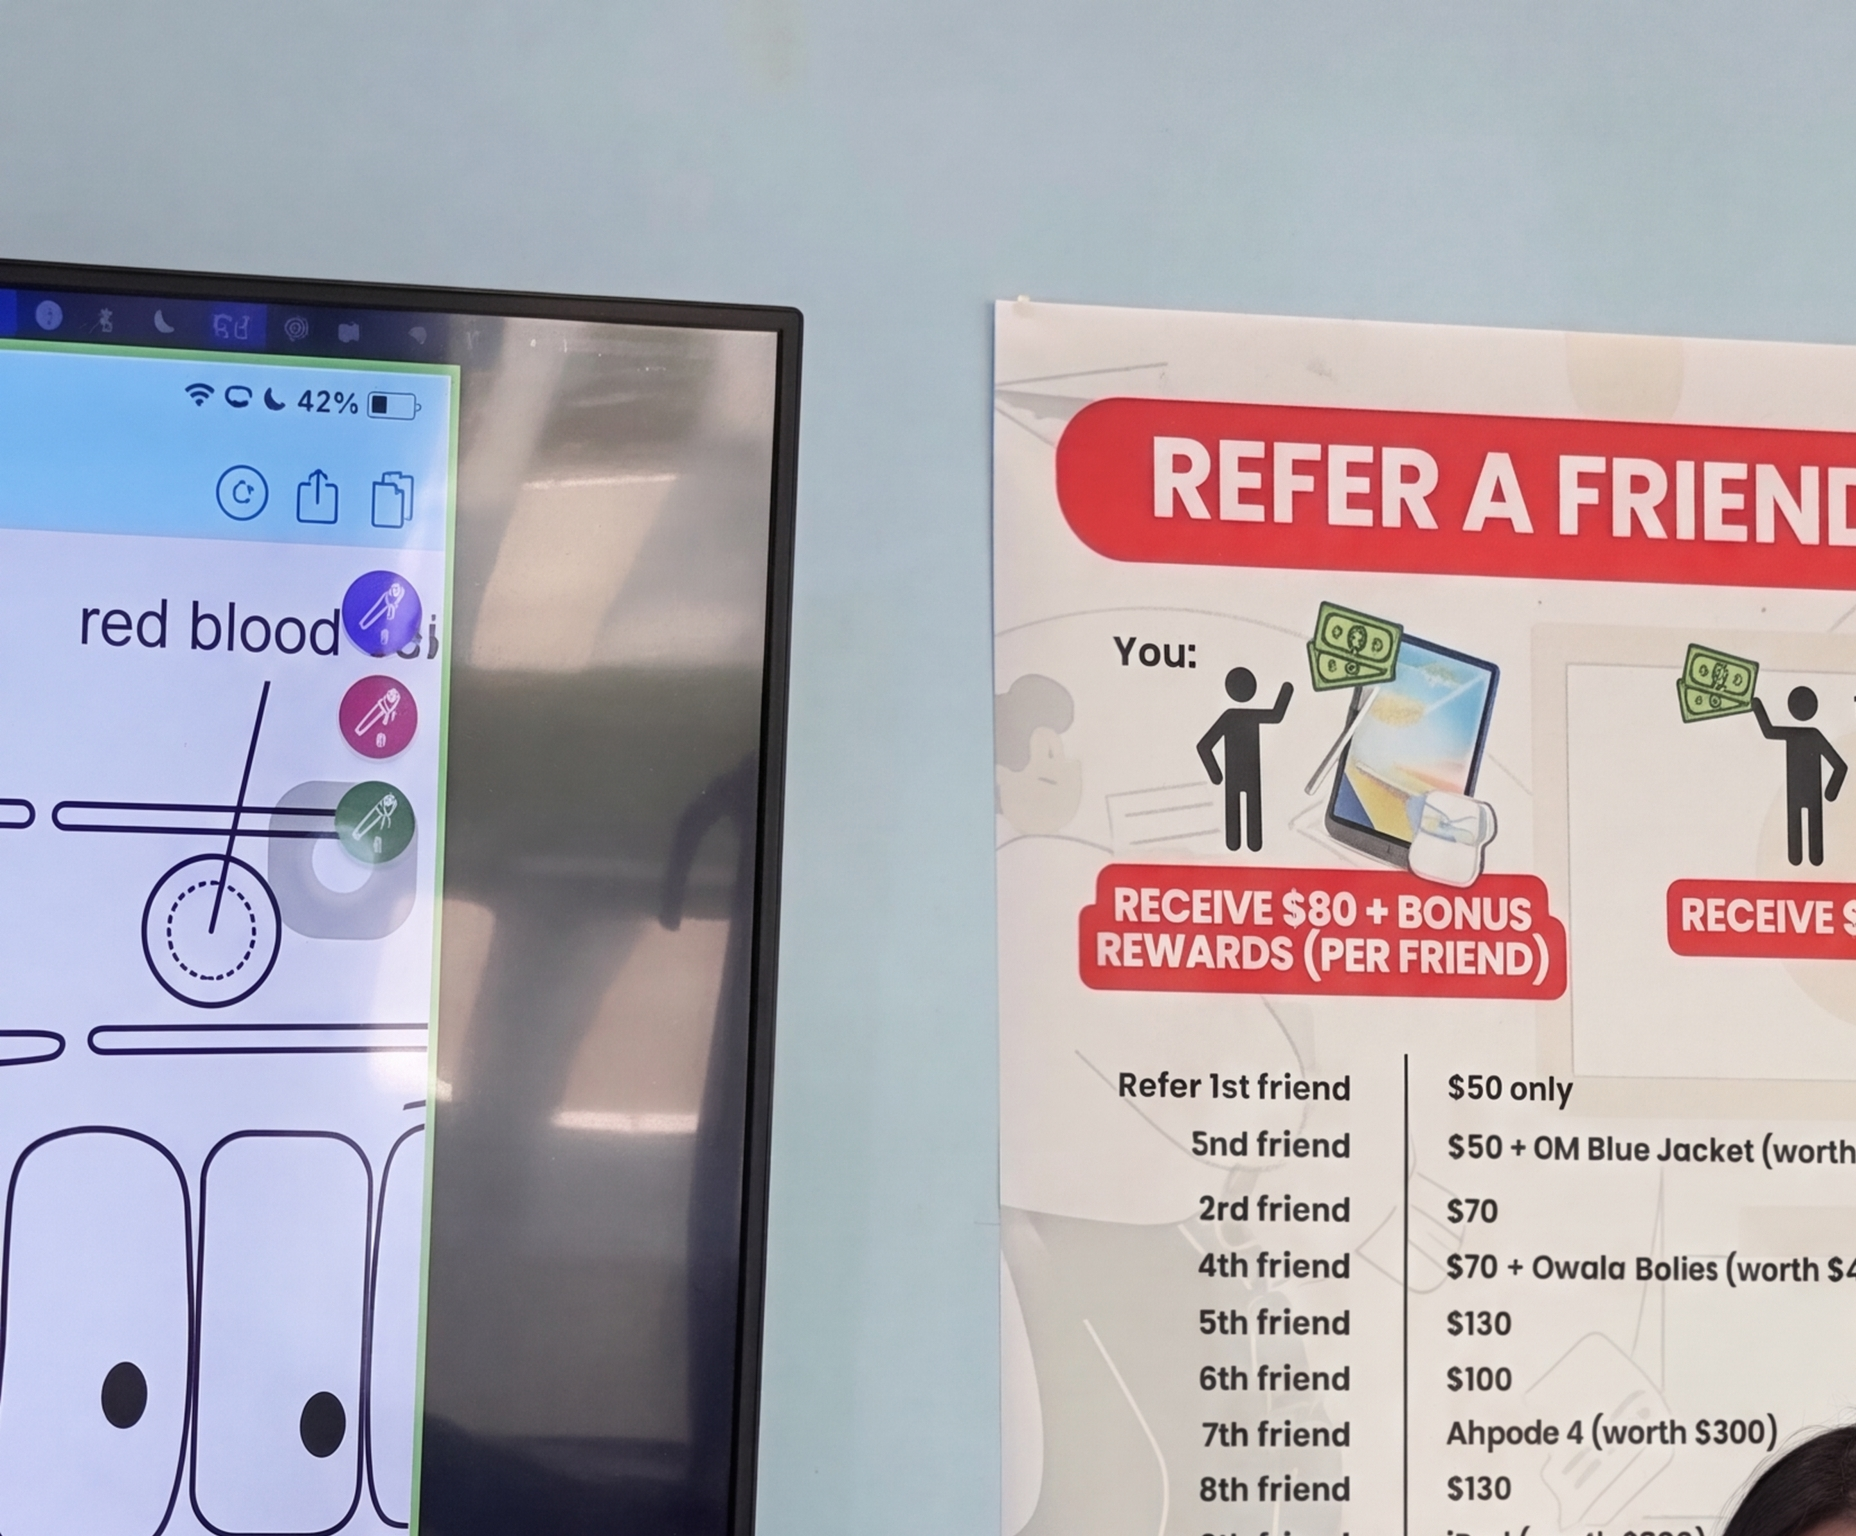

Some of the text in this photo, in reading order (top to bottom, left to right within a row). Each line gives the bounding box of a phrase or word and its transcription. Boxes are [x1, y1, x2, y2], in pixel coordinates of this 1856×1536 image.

[297, 389, 359, 415] 42%
[1153, 436, 1439, 530] REFER
[1462, 451, 1534, 534] A
[81, 598, 168, 649] red
[190, 600, 341, 656] blood
[1113, 636, 1197, 669] You:
[1114, 886, 1532, 932] RECEIVE $80 + BONUS
[1682, 897, 1835, 934] RECEIVE
[1097, 928, 1550, 986] REWARDS (PER FRIEND)
[1119, 1070, 1351, 1102] Refer 1st friend
[1448, 1073, 1574, 1111] $50 only
[1191, 1129, 1350, 1159] 5nd friend
[1448, 1133, 1503, 1160] $50
[1510, 1139, 1527, 1157] +
[1533, 1135, 1579, 1161] OM
[1588, 1135, 1650, 1162] Blue
[1656, 1137, 1755, 1163] Jacket
[1762, 1132, 1856, 1170] (worth
[1199, 1193, 1350, 1223] 2rd friend
[1447, 1198, 1498, 1224] $70
[1198, 1250, 1350, 1279] 4th friend
[1446, 1252, 1498, 1280] $70
[1507, 1258, 1524, 1276] +
[1532, 1254, 1626, 1281] Owala
[1635, 1255, 1718, 1282] Bolies
[1726, 1250, 1819, 1288] (worth
[1199, 1307, 1350, 1336] 5th friend
[1447, 1309, 1512, 1337] $130
[1199, 1363, 1350, 1392] 6th friend
[1446, 1366, 1512, 1392] $100
[1202, 1419, 1350, 1448] 7th friend
[1566, 1419, 1584, 1445] 4
[1592, 1412, 1687, 1451] (worth
[1695, 1412, 1778, 1452] $300)
[1199, 1474, 1350, 1502] 8th friend
[1447, 1475, 1512, 1502] $130
